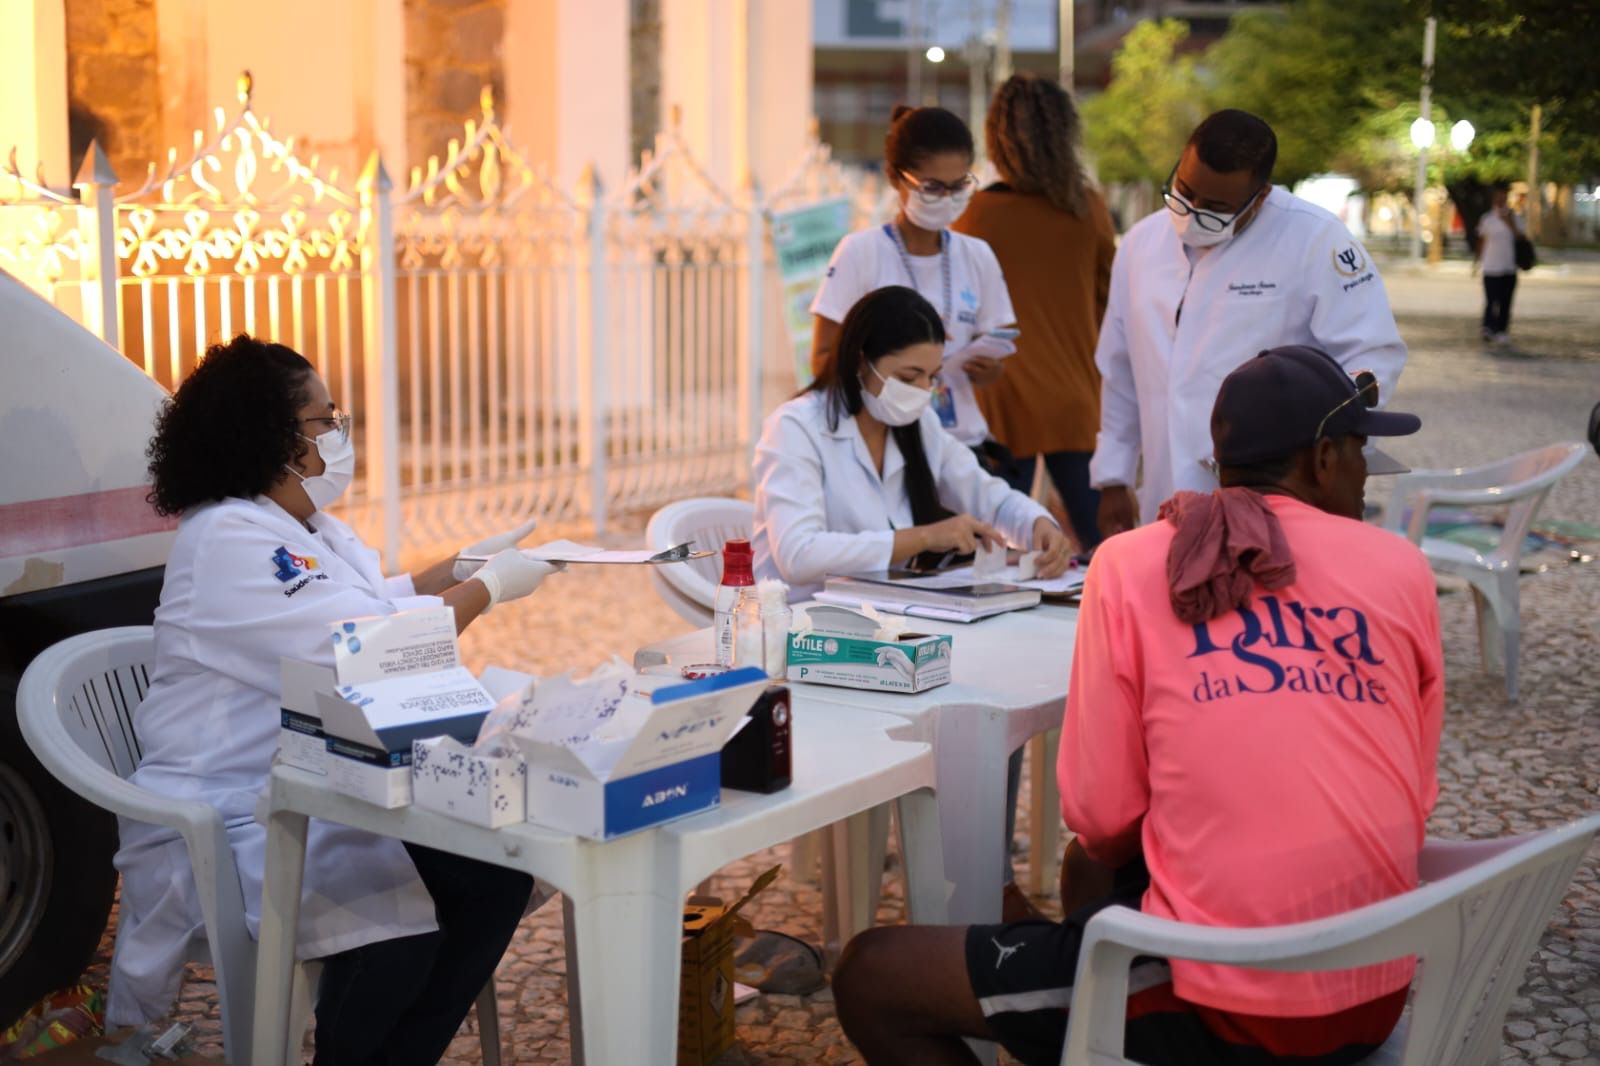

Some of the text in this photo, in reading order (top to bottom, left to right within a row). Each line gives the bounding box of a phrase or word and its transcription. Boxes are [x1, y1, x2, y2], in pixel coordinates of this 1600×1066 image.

[800, 667, 809, 679] P
[1193, 632, 1388, 705] da Saúde
